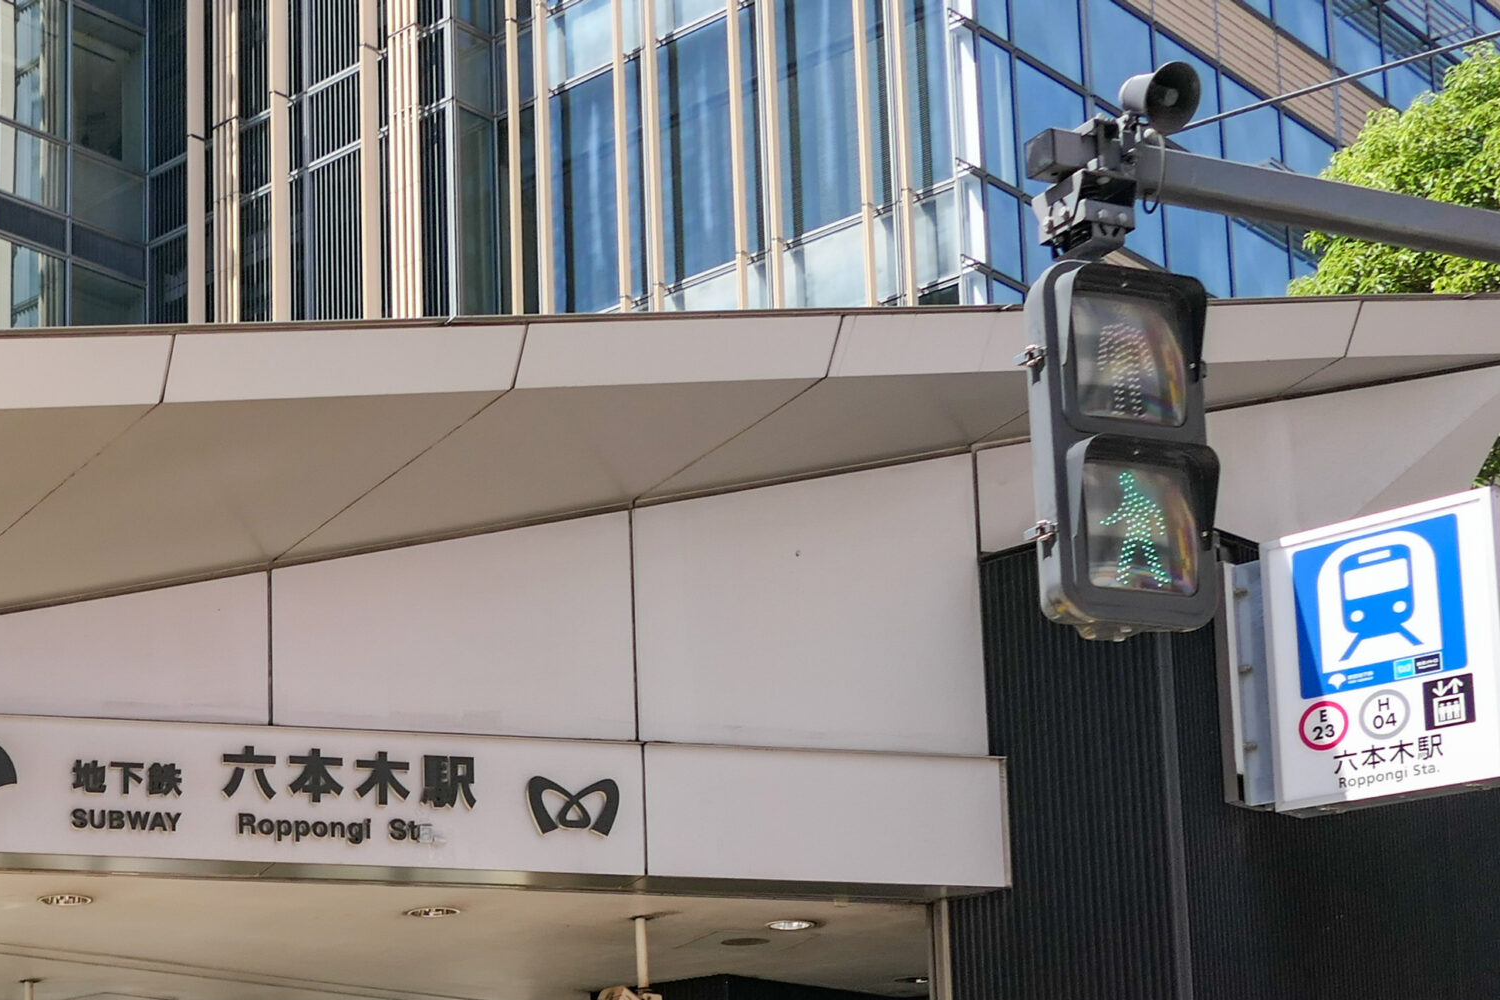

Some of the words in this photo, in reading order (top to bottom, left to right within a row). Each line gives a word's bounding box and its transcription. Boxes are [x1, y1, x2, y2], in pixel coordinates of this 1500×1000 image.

[1319, 709, 1328, 723] E
[1377, 697, 1390, 712] H
[1312, 723, 1336, 741] 23
[1372, 712, 1397, 730] 04
[1333, 733, 1443, 775] 六本木駅
[71, 759, 183, 798] 地下鉄
[221, 745, 477, 810] 六本木駅
[1338, 768, 1408, 789] Roppongi
[1412, 763, 1441, 776] Sta.
[70, 808, 182, 833] SUBWAY
[237, 812, 372, 845] Roppongi
